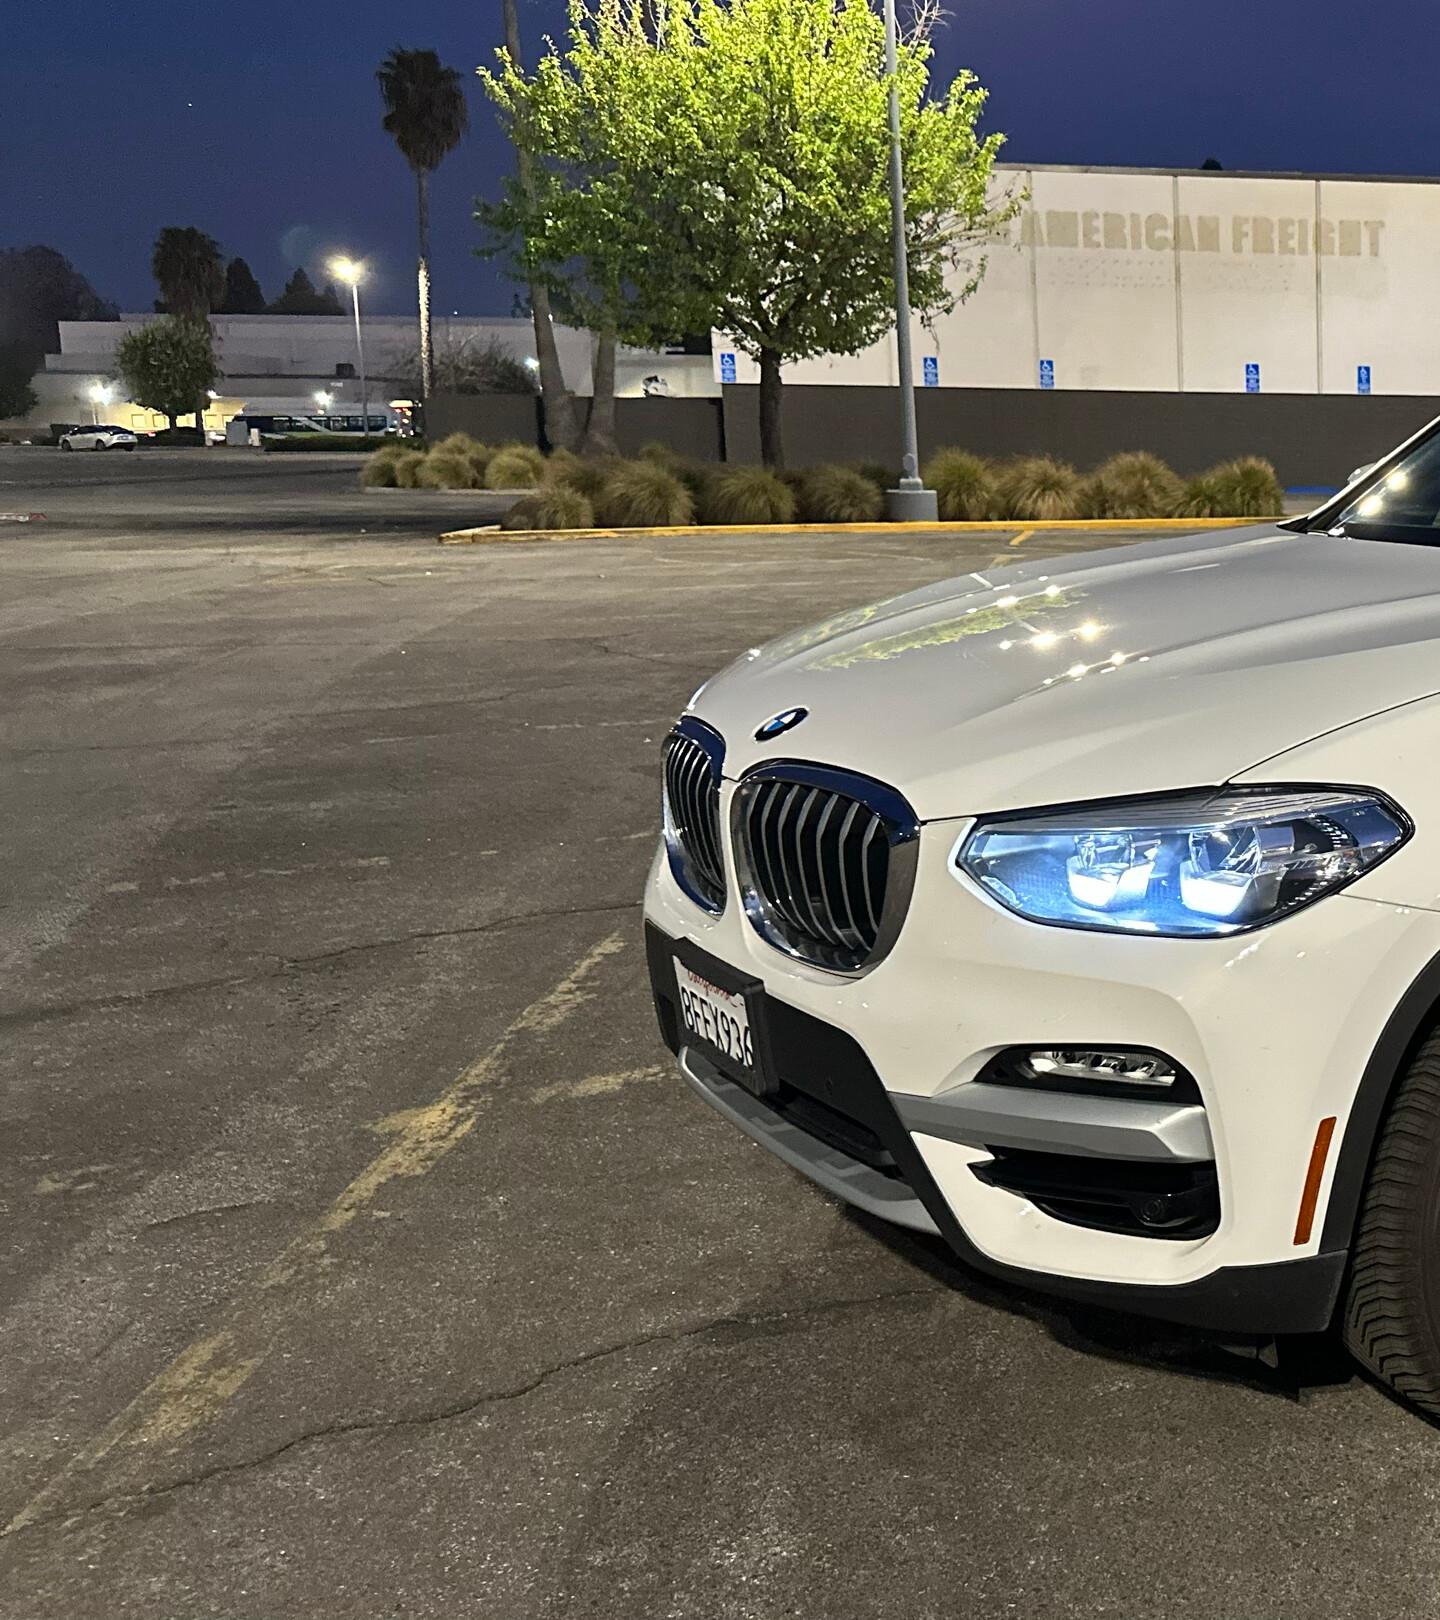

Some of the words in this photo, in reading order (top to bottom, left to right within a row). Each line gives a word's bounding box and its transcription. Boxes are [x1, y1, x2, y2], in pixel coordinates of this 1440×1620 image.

[1021, 209, 1221, 252] AMERICAN
[1232, 214, 1385, 257] FREIGHT
[681, 985, 753, 1068] 8FEX936
